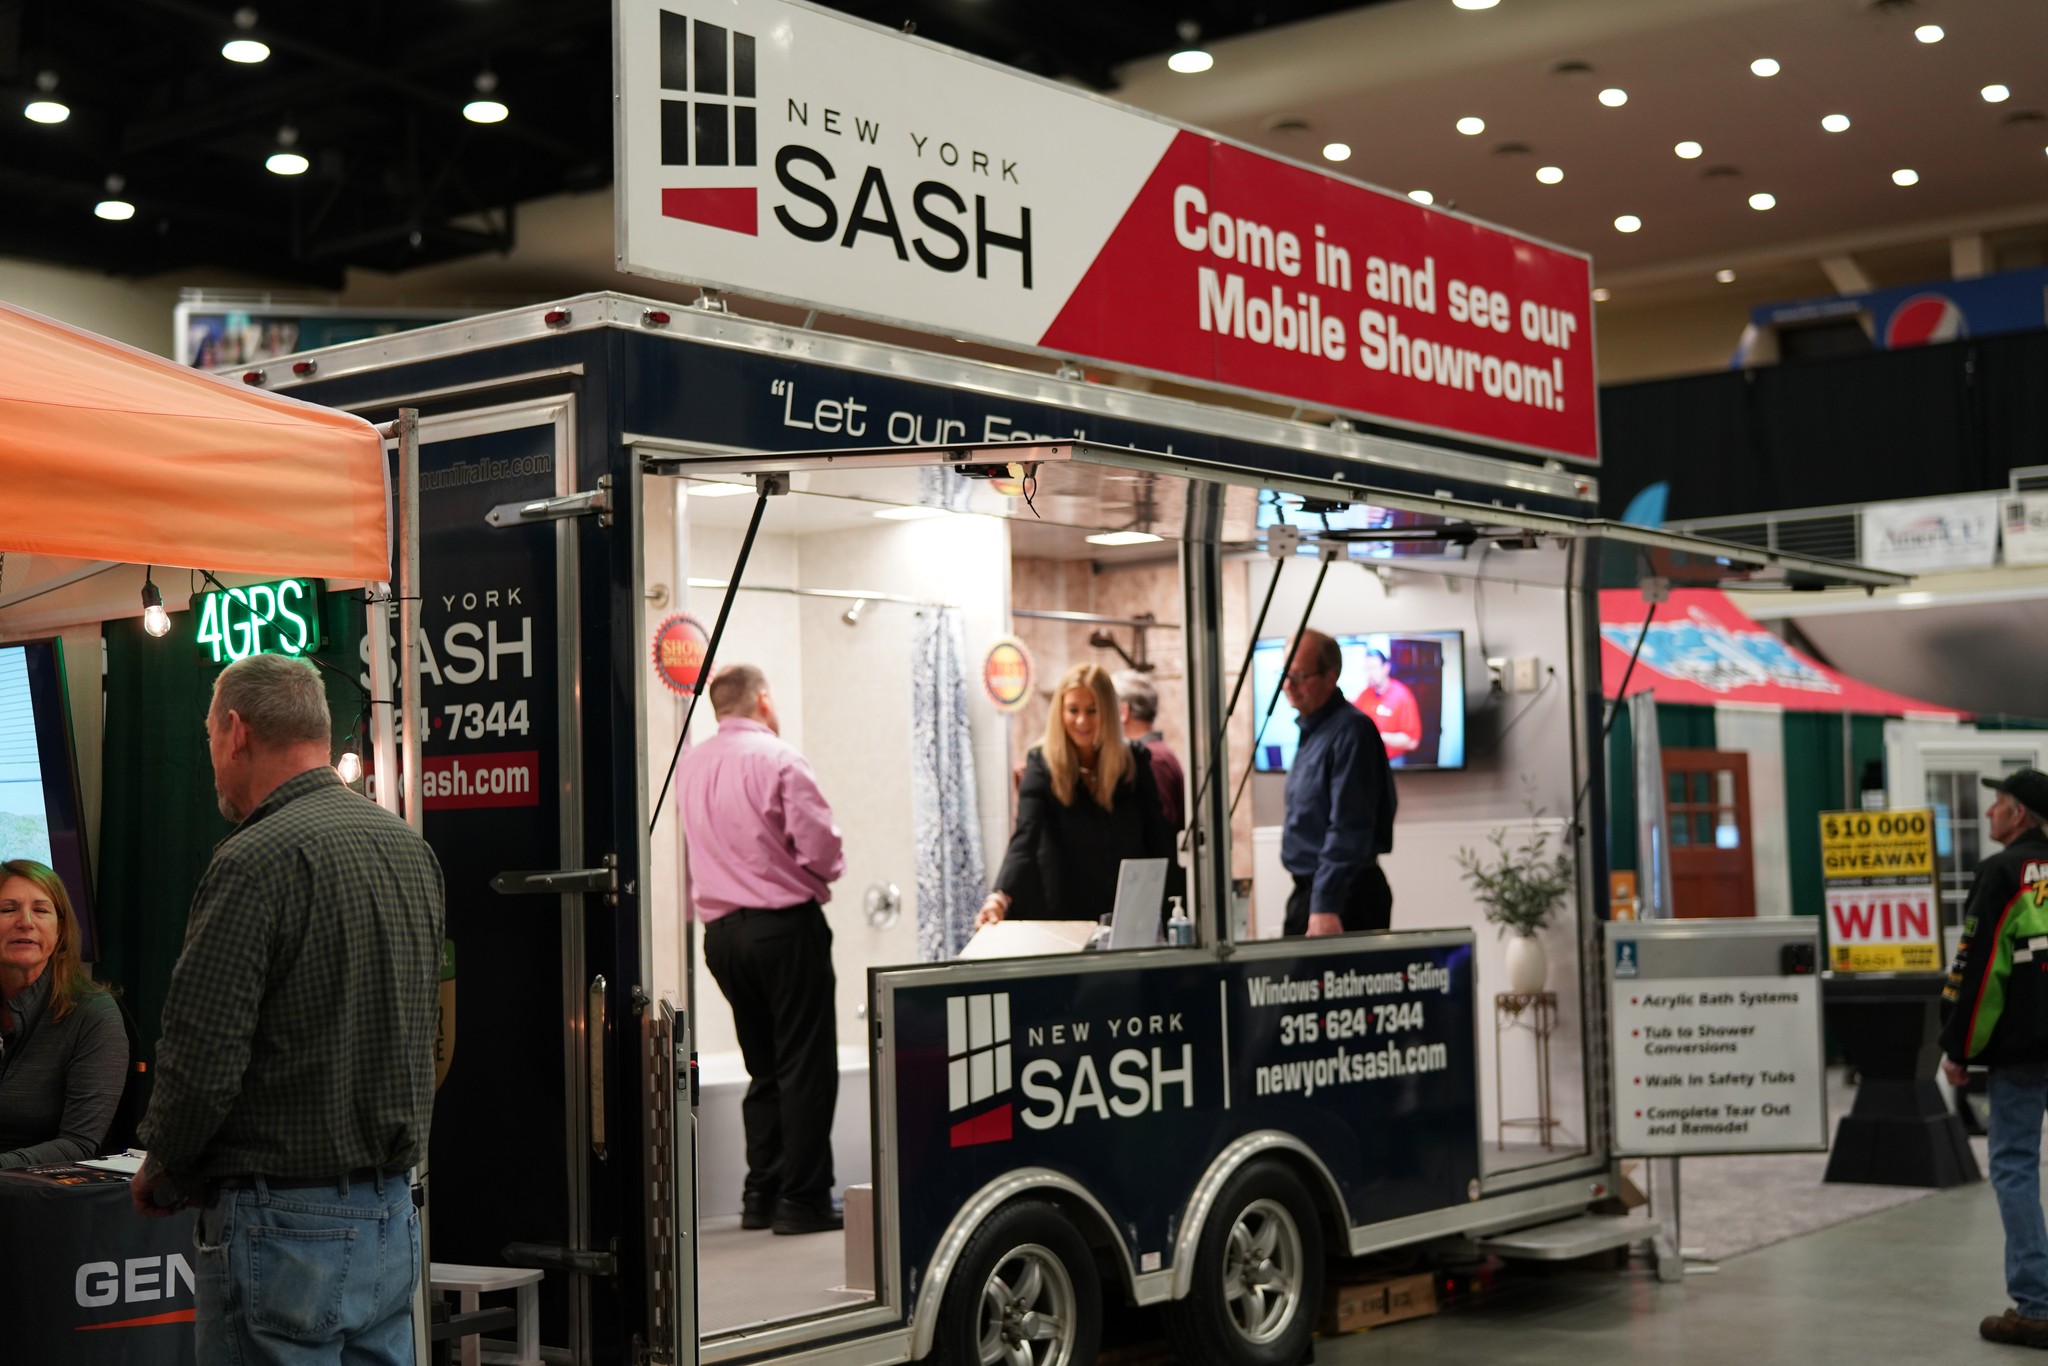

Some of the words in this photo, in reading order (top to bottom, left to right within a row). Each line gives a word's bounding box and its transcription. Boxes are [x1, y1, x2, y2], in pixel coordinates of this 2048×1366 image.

[788, 98, 880, 144] NEW
[910, 132, 1019, 185] YORK
[773, 144, 1033, 290] SASH
[1173, 184, 1301, 278] Come
[1314, 224, 1352, 292] in
[1365, 256, 1436, 315] and
[1447, 278, 1510, 334] see
[1520, 299, 1577, 351] our
[1198, 266, 1346, 362] Mobile
[1358, 308, 1566, 413] Showroom!
[887, 410, 966, 445] our
[443, 588, 522, 612] YORK
[197, 580, 308, 661] 4GPS
[444, 699, 530, 740] 7344
[1825, 852, 1926, 869] GIVEAWAY
[1833, 902, 1929, 938] WIN
[1248, 975, 1320, 1007] Windows
[1323, 969, 1404, 1000] Bathrooms
[1407, 962, 1450, 994] Siding
[1643, 992, 1693, 1010] Acrylic
[1700, 992, 1734, 1006] Bath
[1739, 991, 1799, 1009] Systems
[1028, 1021, 1090, 1047] NEW
[1108, 1013, 1184, 1038] YORK
[1644, 1025, 1672, 1039] Tub
[1677, 1026, 1693, 1038] to
[1699, 1024, 1756, 1038] Shower
[1645, 1040, 1738, 1056] Conversions
[1256, 1040, 1447, 1098] newyorksash.com
[1646, 1073, 1683, 1087] Walk
[1709, 1071, 1755, 1090] Safety
[1760, 1070, 1796, 1084] Tubs
[1020, 1043, 1194, 1131] SASH
[1647, 1105, 1719, 1121] Complete
[1725, 1104, 1756, 1117] Tear
[1761, 1102, 1791, 1116] Out
[1647, 1123, 1676, 1137] and
[1681, 1120, 1748, 1136] Remodel
